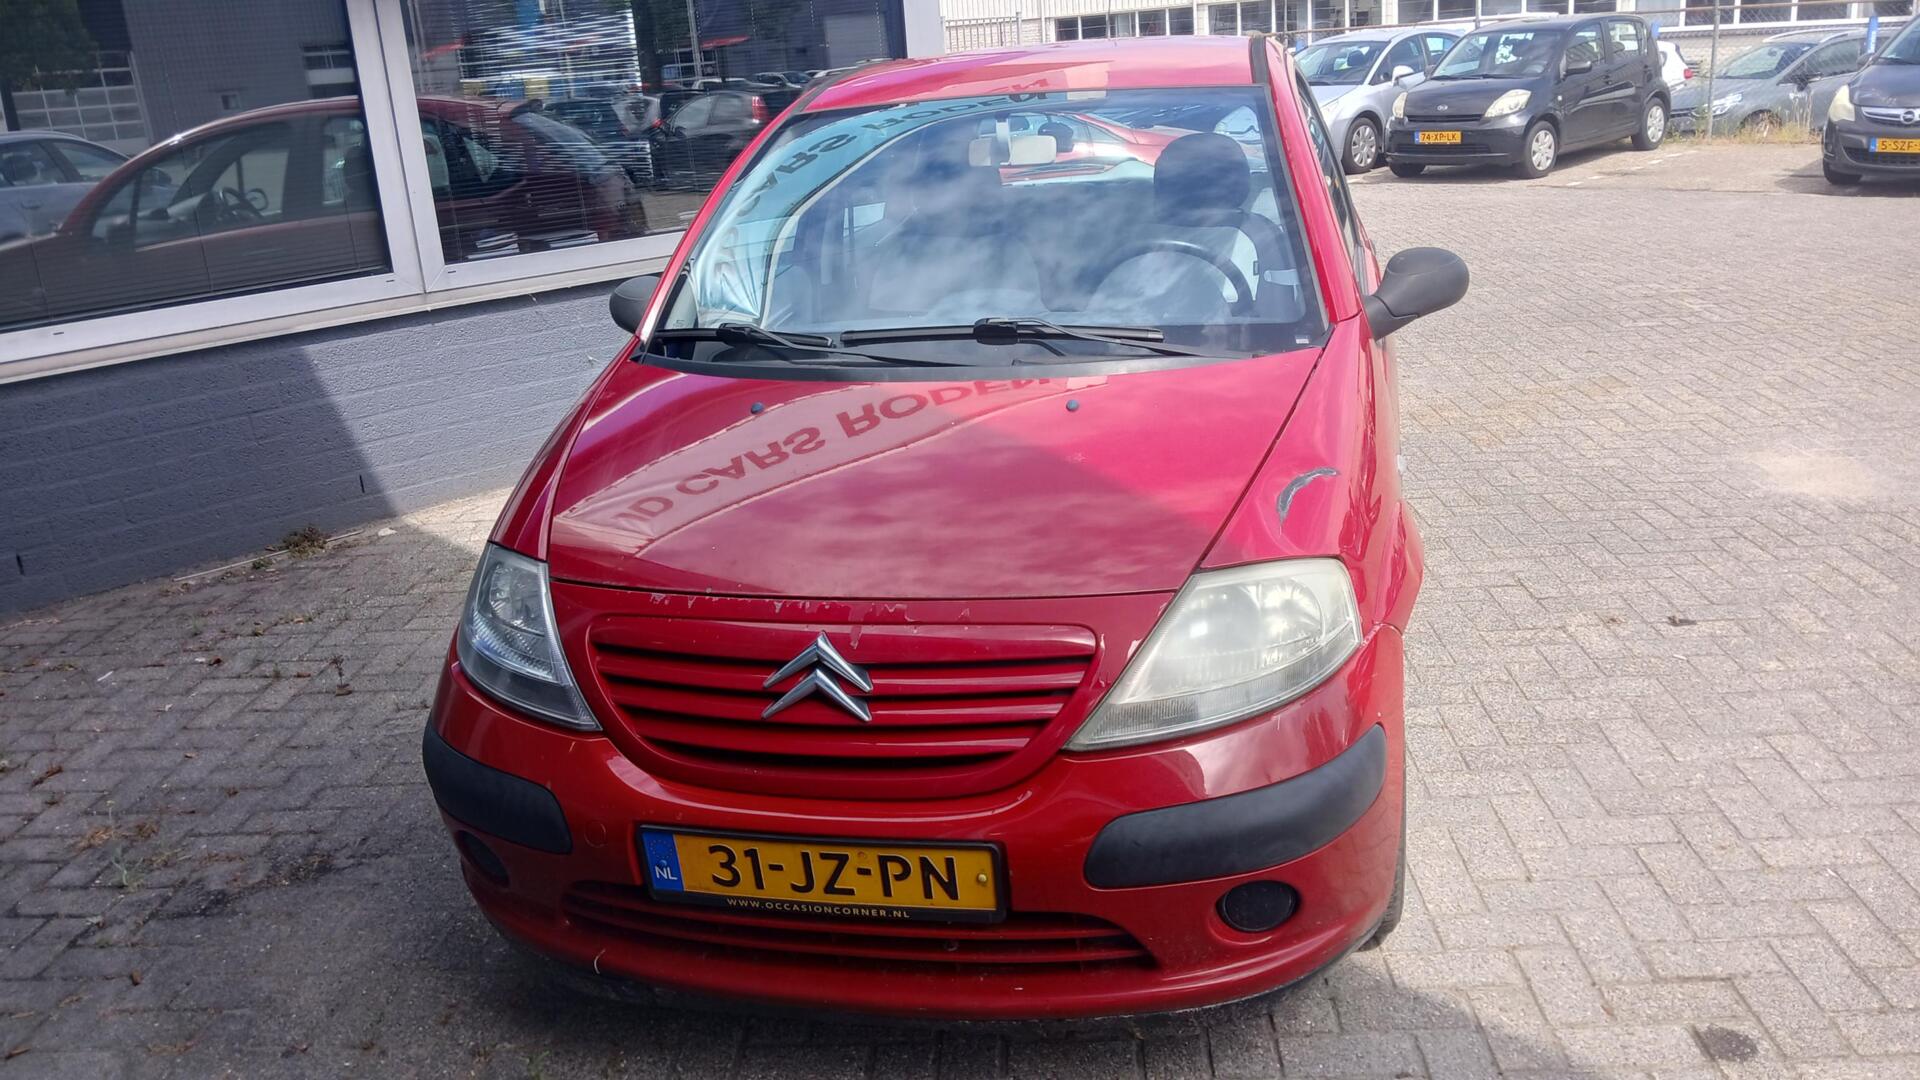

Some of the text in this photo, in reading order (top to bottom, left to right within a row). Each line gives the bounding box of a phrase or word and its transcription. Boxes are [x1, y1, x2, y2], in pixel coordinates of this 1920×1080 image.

[1421, 132, 1457, 142] 74-XP-LK
[1880, 140, 1920, 151] 5-SZF-
[655, 866, 678, 881] NL
[708, 844, 960, 901] 31-JZ-PN
[726, 897, 911, 919] WWW.OCCASIONCORNER.NL
